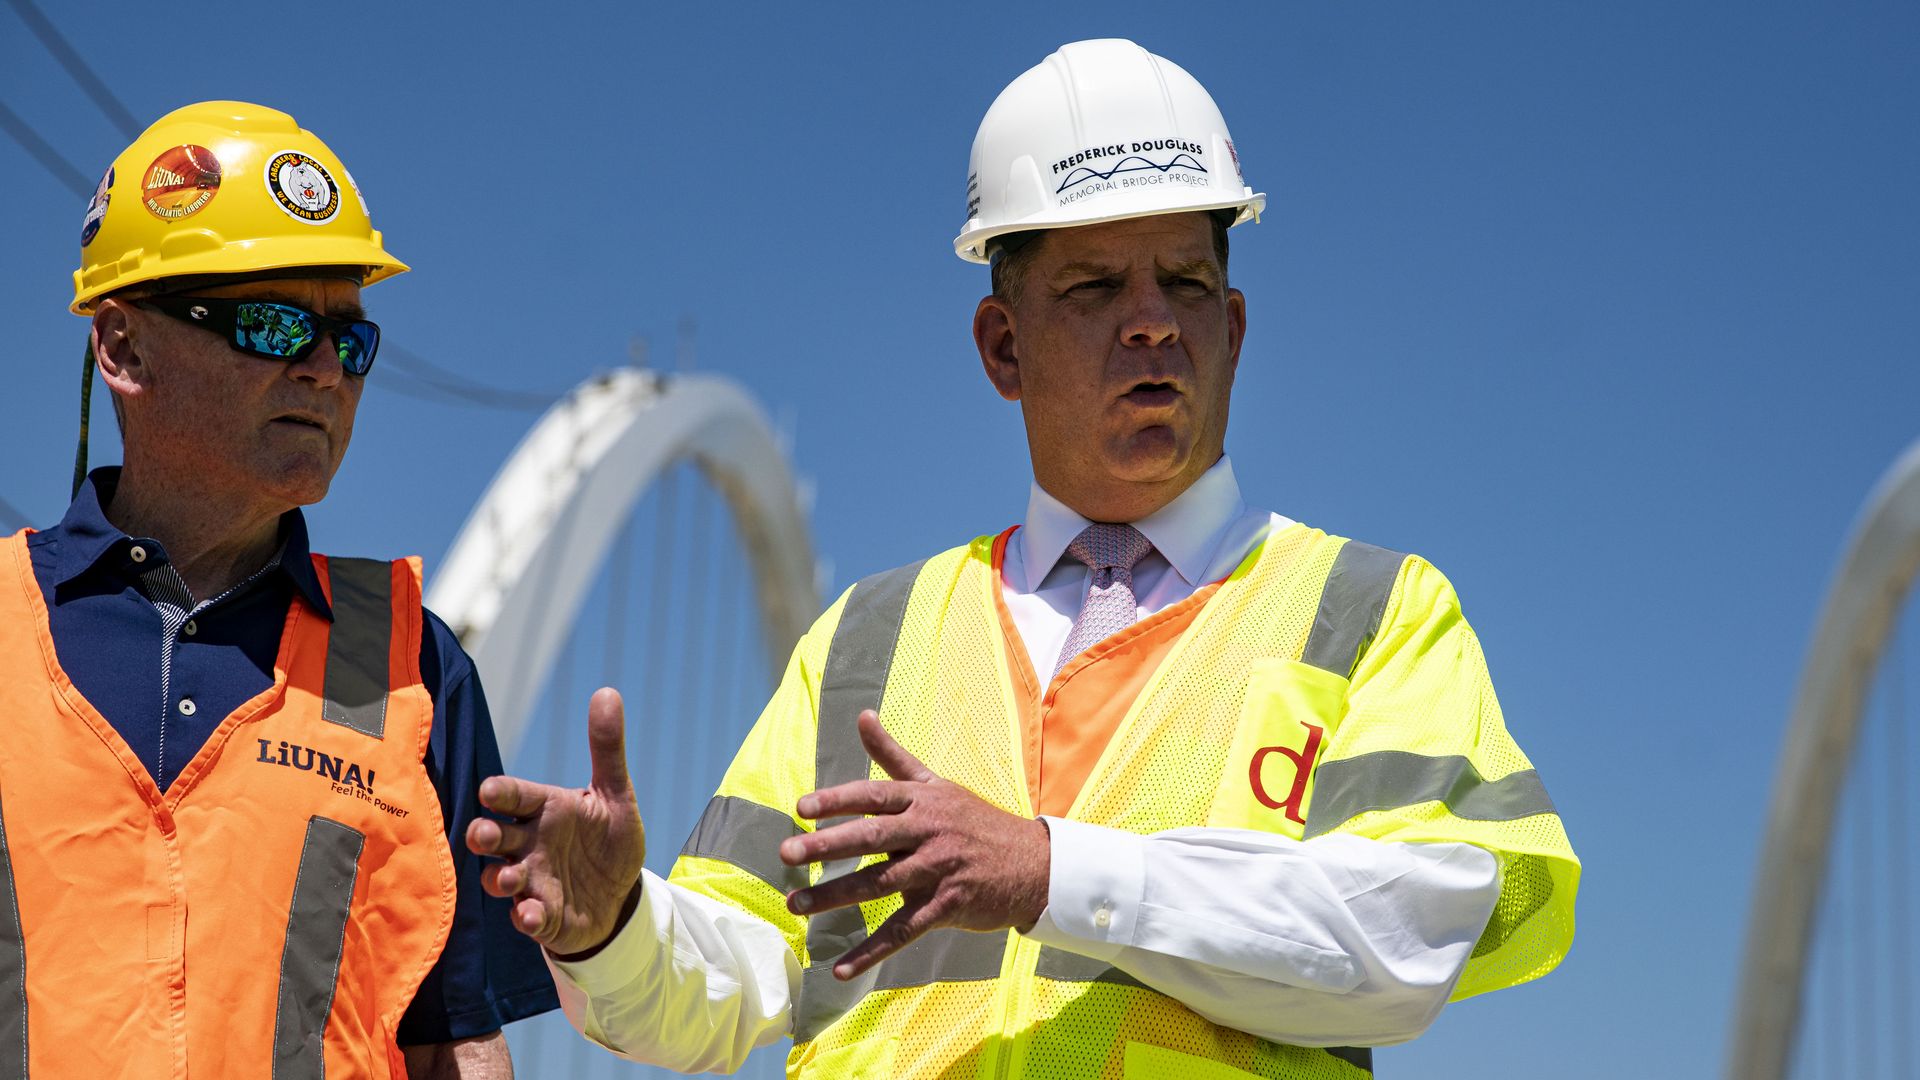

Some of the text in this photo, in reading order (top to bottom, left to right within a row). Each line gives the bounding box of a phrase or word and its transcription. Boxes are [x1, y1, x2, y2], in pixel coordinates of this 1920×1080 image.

[298, 155, 323, 173] LOCAL
[1052, 138, 1203, 175] FREDERICK DOUGLASS
[147, 166, 185, 190] LiUNA!
[1059, 172, 1209, 208] MEMORIAL BRIDGE PROJECT
[147, 190, 211, 218] MID-ATLANTIC LABORERS
[276, 190, 338, 219] WE MEAN BUSINESS!
[256, 738, 376, 795] LiUNA!
[1249, 720, 1324, 826] d
[331, 781, 410, 820] Feel the Power
